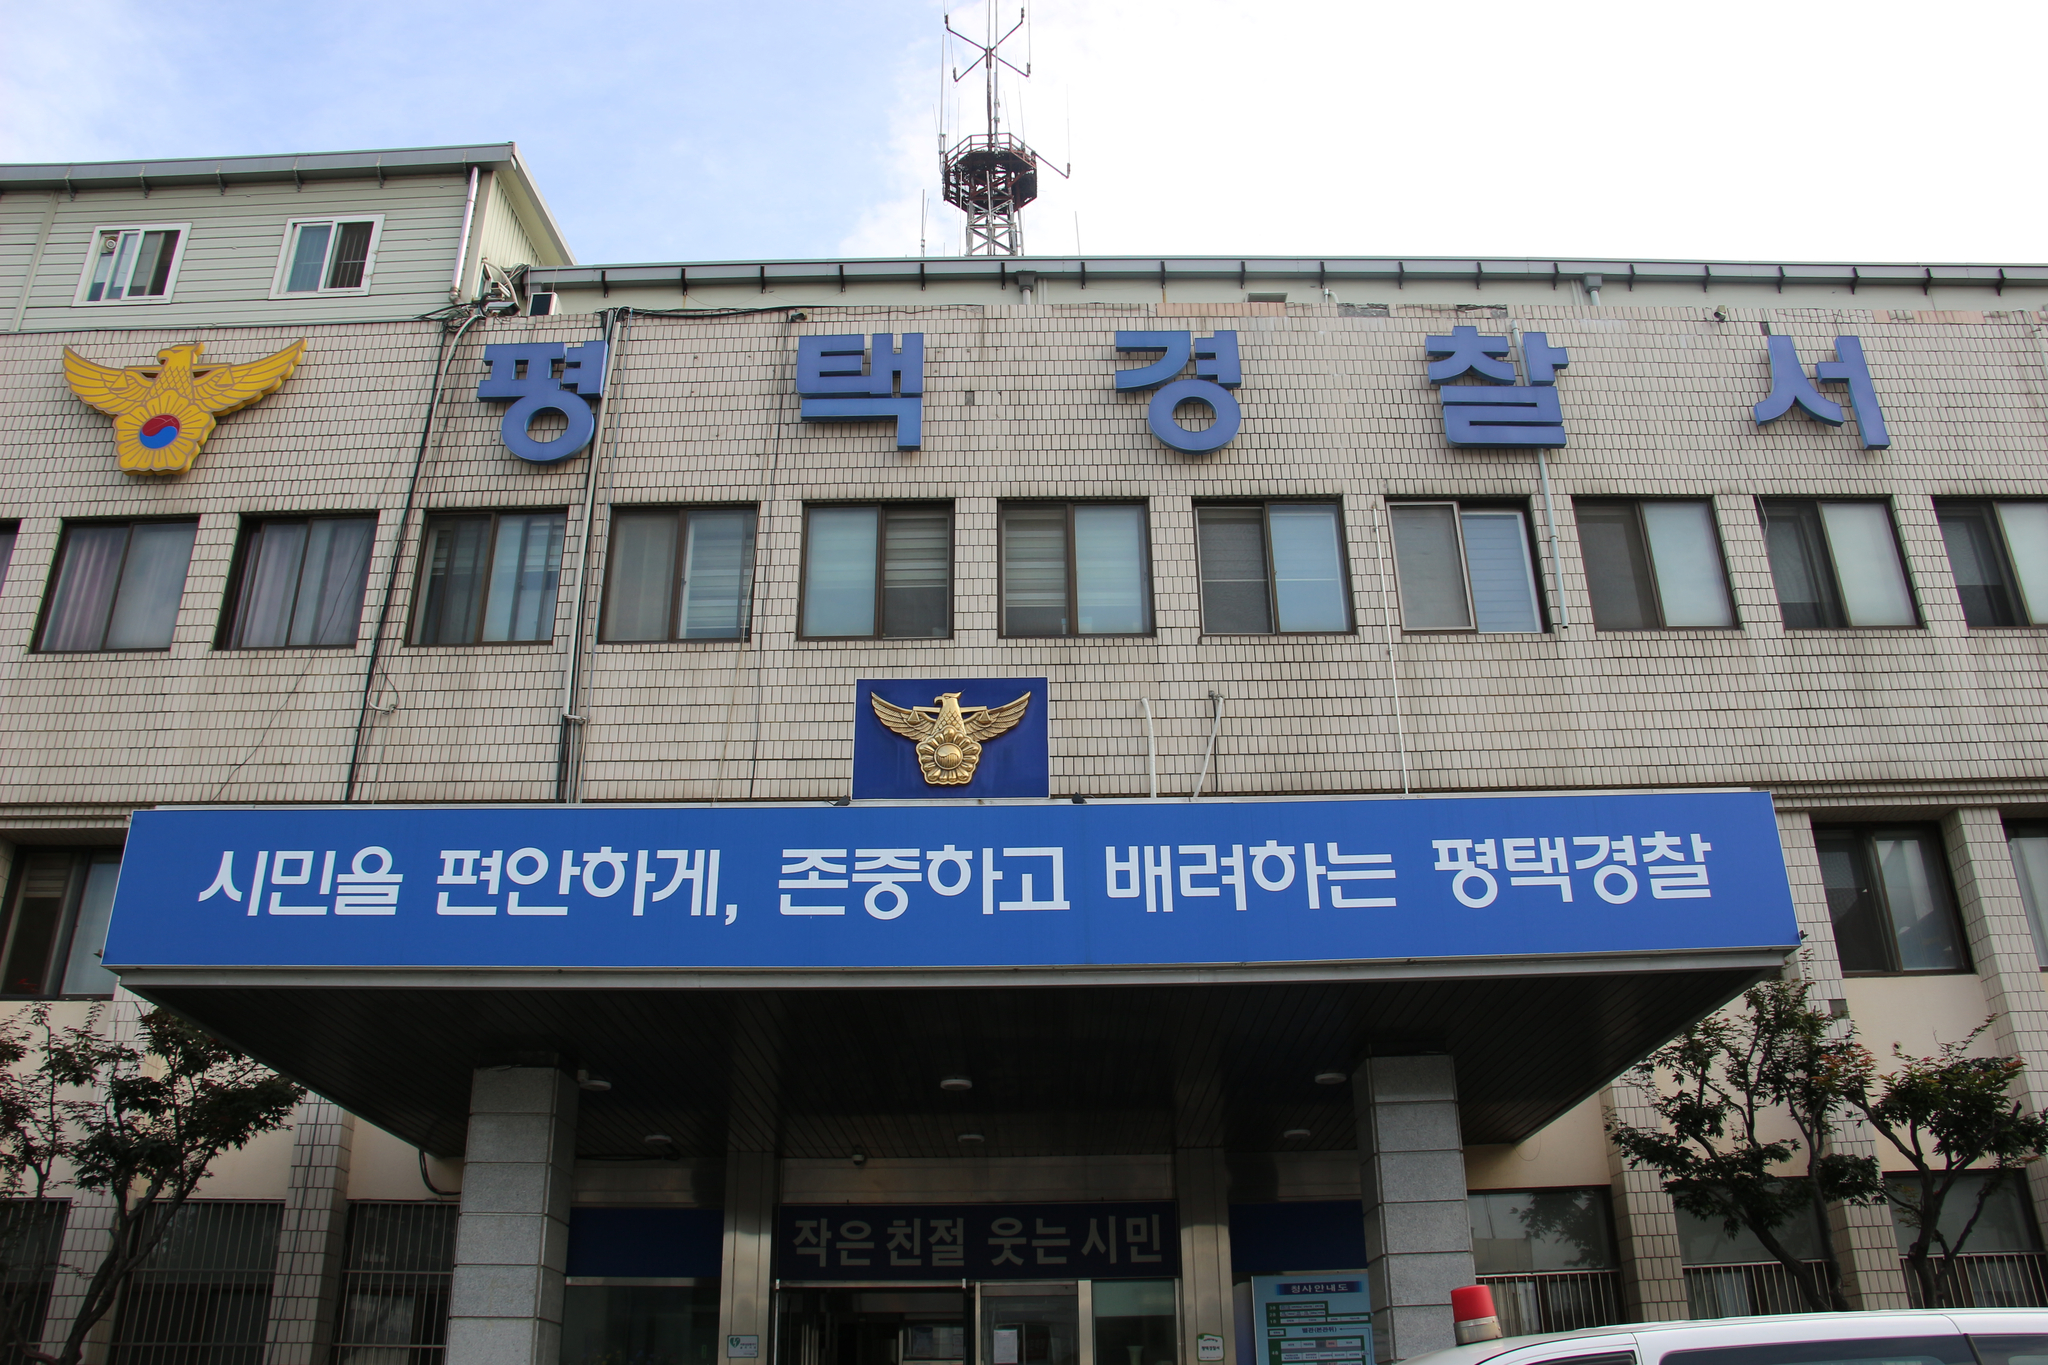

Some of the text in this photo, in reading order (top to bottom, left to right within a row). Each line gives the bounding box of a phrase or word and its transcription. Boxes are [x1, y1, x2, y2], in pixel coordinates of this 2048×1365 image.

[477, 325, 1891, 465] 평택경찰서
[198, 830, 1712, 927] 시민을 편안하게, 존중하고 배려하는 평택경찰
[793, 1214, 1162, 1267] 작은 친절 웃는 시민
[1290, 1283, 1349, 1294] 청사안내도
